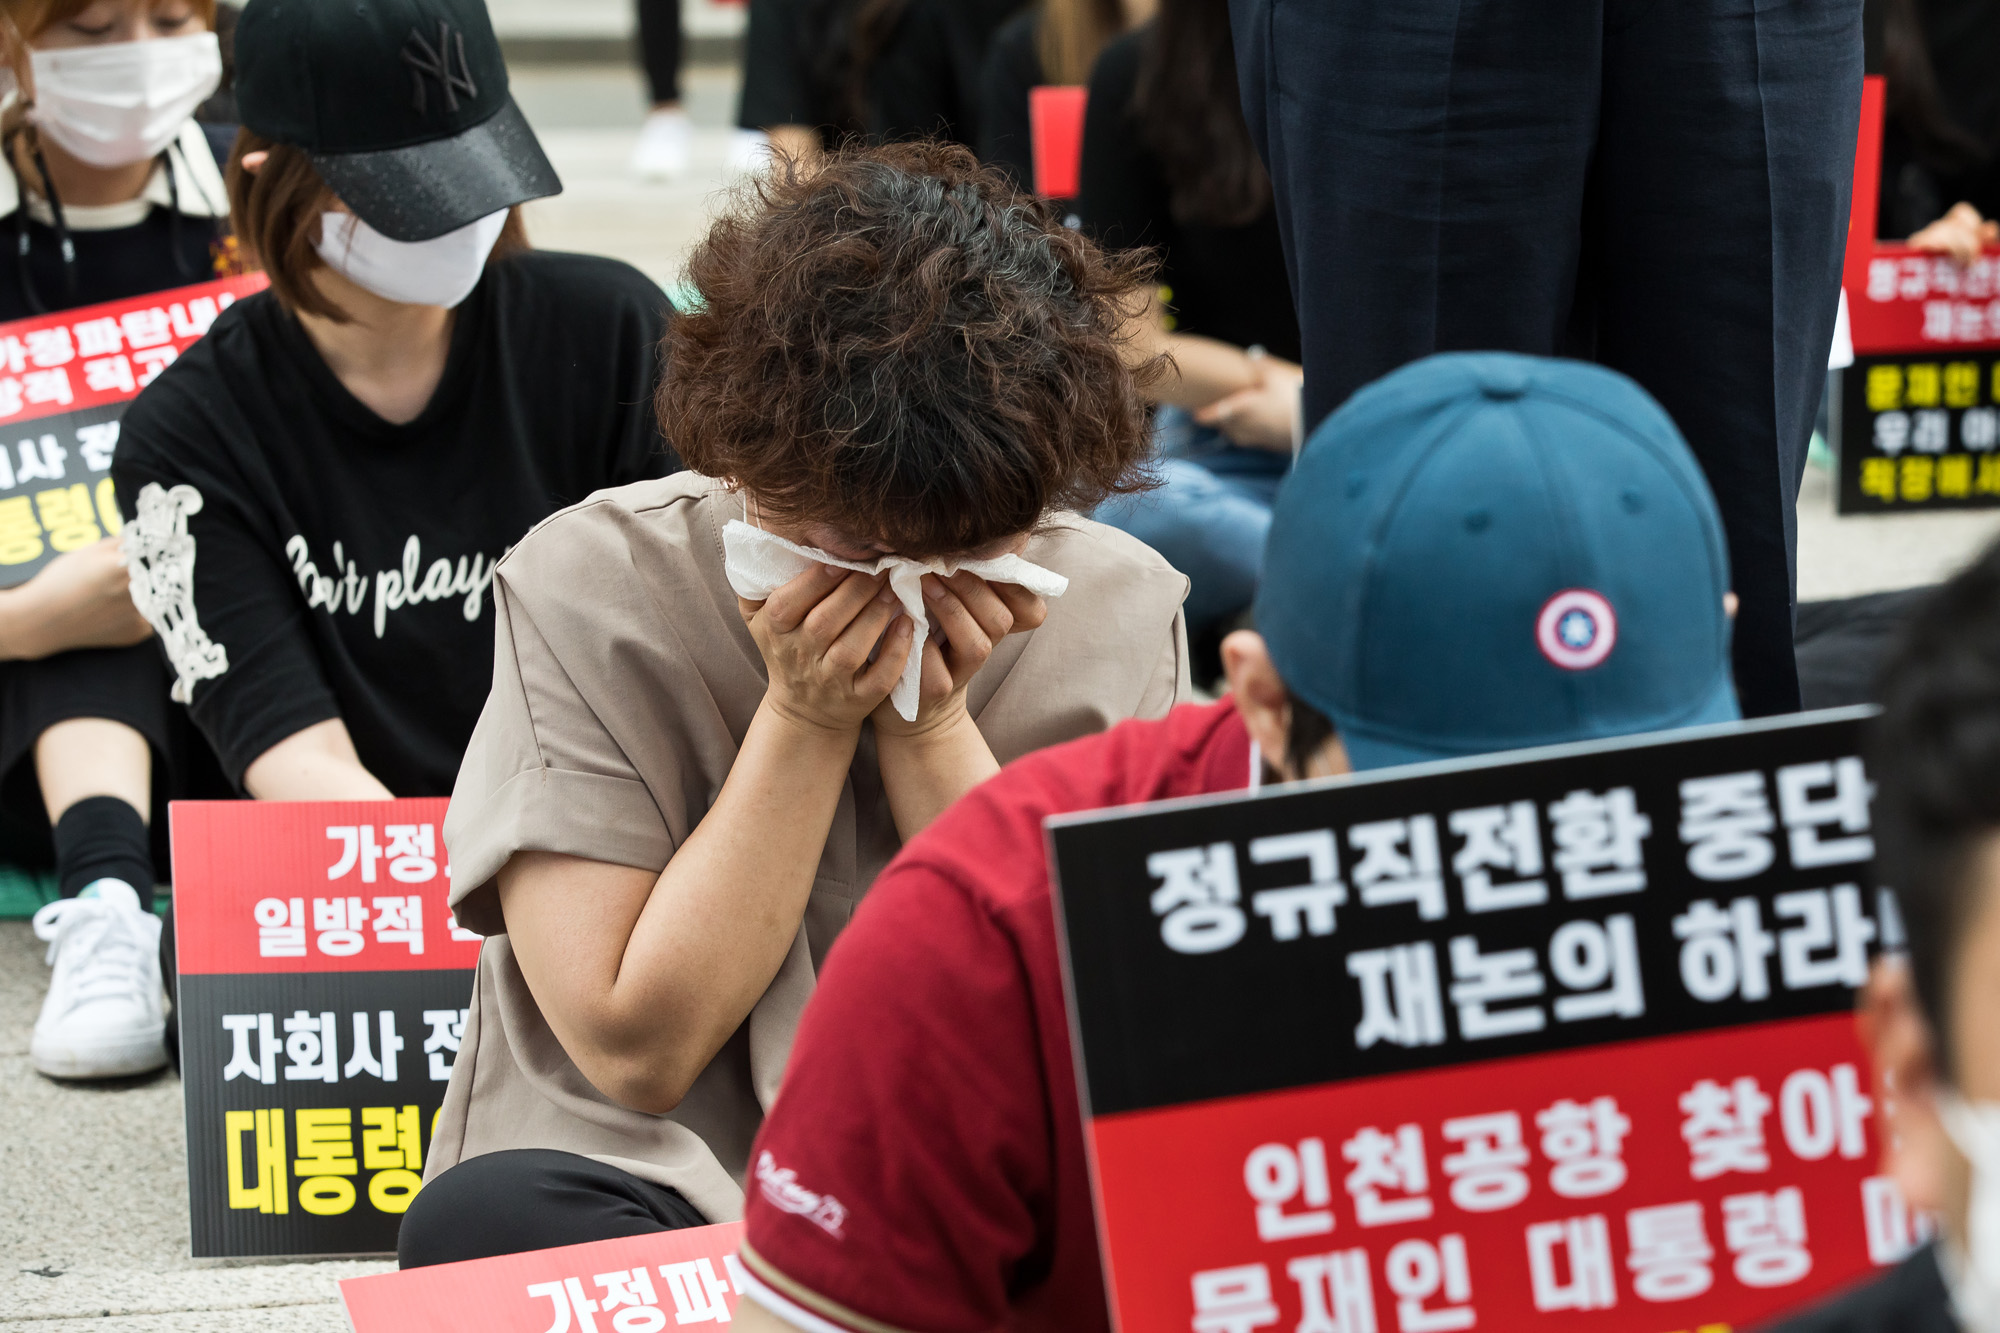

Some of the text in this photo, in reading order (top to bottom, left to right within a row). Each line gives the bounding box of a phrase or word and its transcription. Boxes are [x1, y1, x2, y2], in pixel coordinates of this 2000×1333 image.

[0, 292, 235, 373] 가정파탄내
[326, 823, 451, 884] 가정
[1146, 755, 1879, 954] 정규직전환 중단
[254, 896, 425, 957] 일방적
[1346, 913, 1646, 1050] 재논의
[222, 1010, 404, 1085] 자회사
[225, 1104, 443, 1216] 대통령
[1243, 1062, 1902, 1242] 인천공항 찾아
[1190, 1232, 1477, 1333] 문재인
[1525, 1186, 1813, 1312] 대통령
